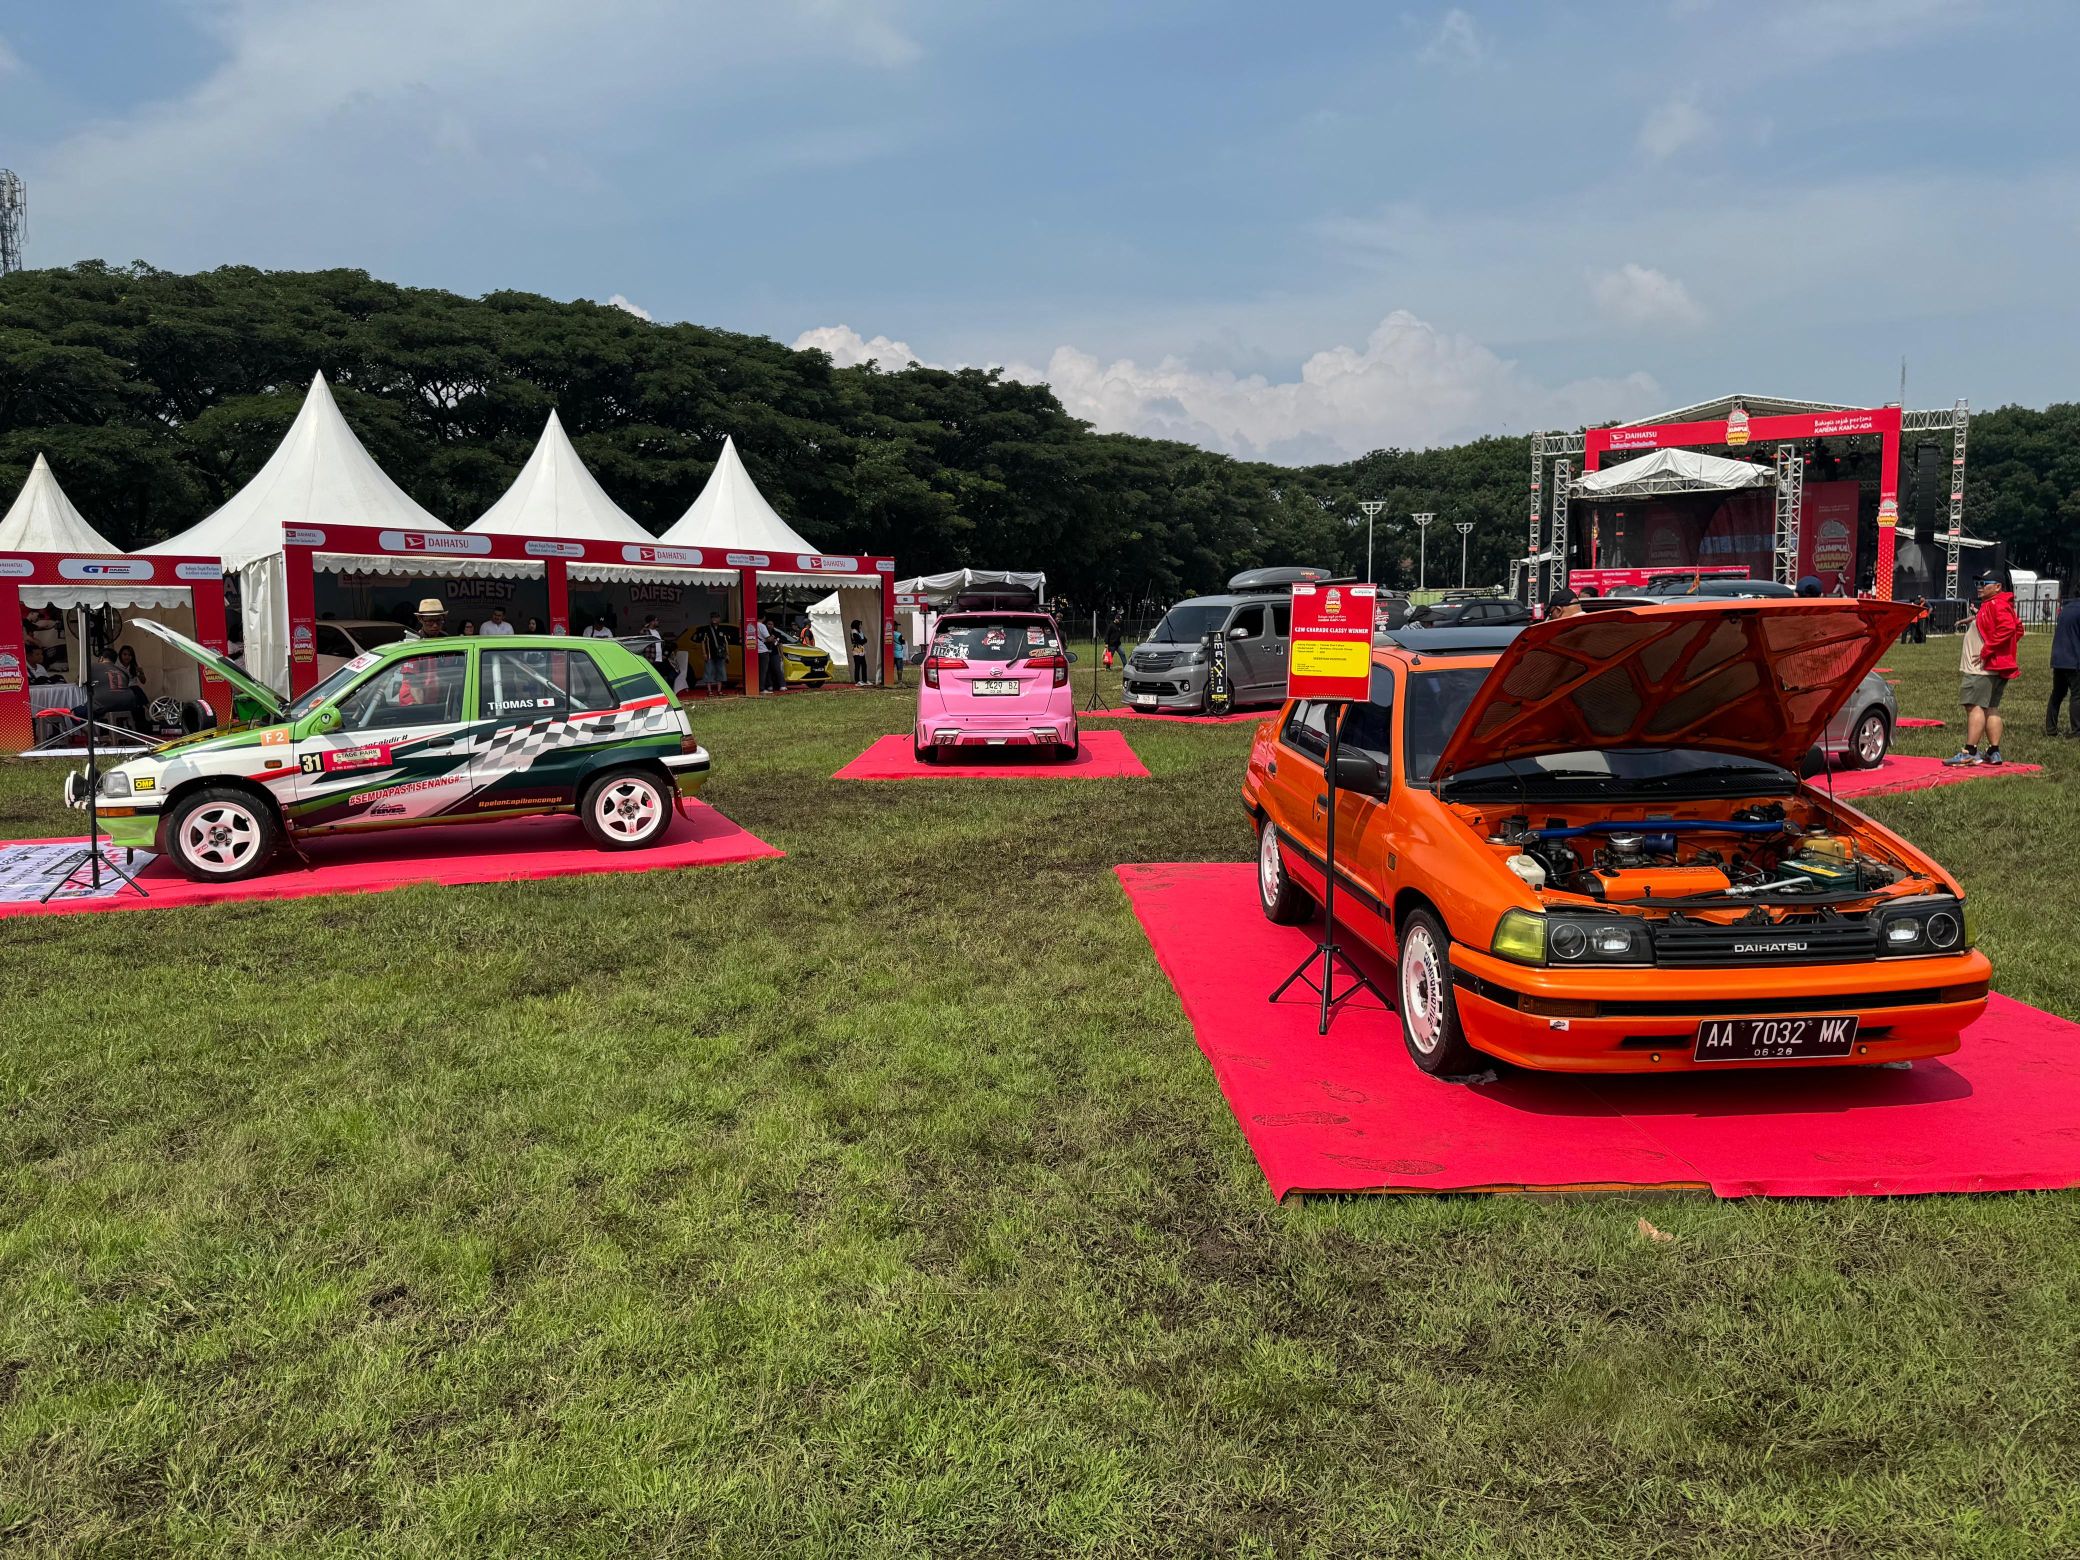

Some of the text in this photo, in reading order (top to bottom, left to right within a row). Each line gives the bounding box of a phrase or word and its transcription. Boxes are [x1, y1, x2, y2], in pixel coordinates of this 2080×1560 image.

[1625, 431, 1657, 439] DAIHATSU
[428, 537, 469, 548] DAIHATSU
[1817, 544, 1847, 553] KUMPUL
[657, 551, 687, 560] DAIHATSU
[823, 560, 846, 568] DAIHATSU
[447, 580, 515, 599] DAIFEST
[630, 586, 682, 602] DAIFEST
[487, 699, 533, 711] THOMAS
[265, 731, 285, 743] F 2
[302, 753, 322, 773] 31
[349, 776, 460, 805] #SEMUAPASTISENANG#
[1734, 942, 1808, 953] DAIHATSU
[1423, 951, 1437, 1029] COMPOMOTIVE
[1706, 1020, 1850, 1047] AA 7032 MK
